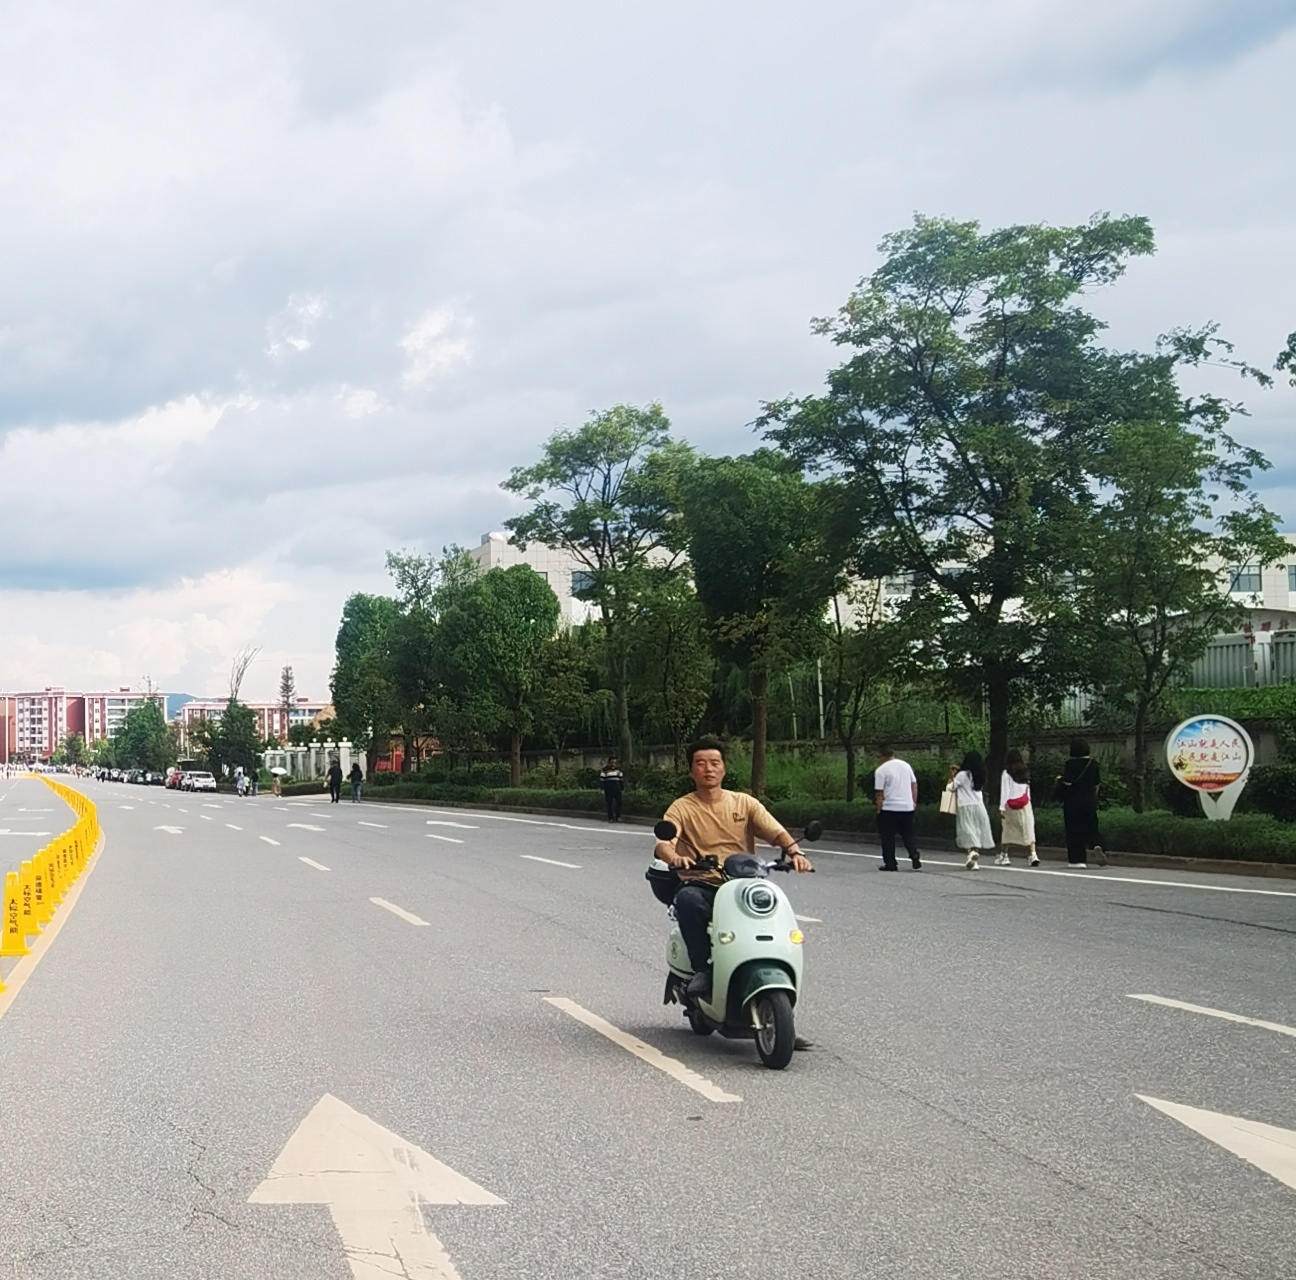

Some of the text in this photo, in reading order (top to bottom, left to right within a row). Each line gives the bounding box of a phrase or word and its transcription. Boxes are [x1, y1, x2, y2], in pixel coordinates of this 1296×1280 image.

[1177, 738, 1241, 750] 江山就是人民
